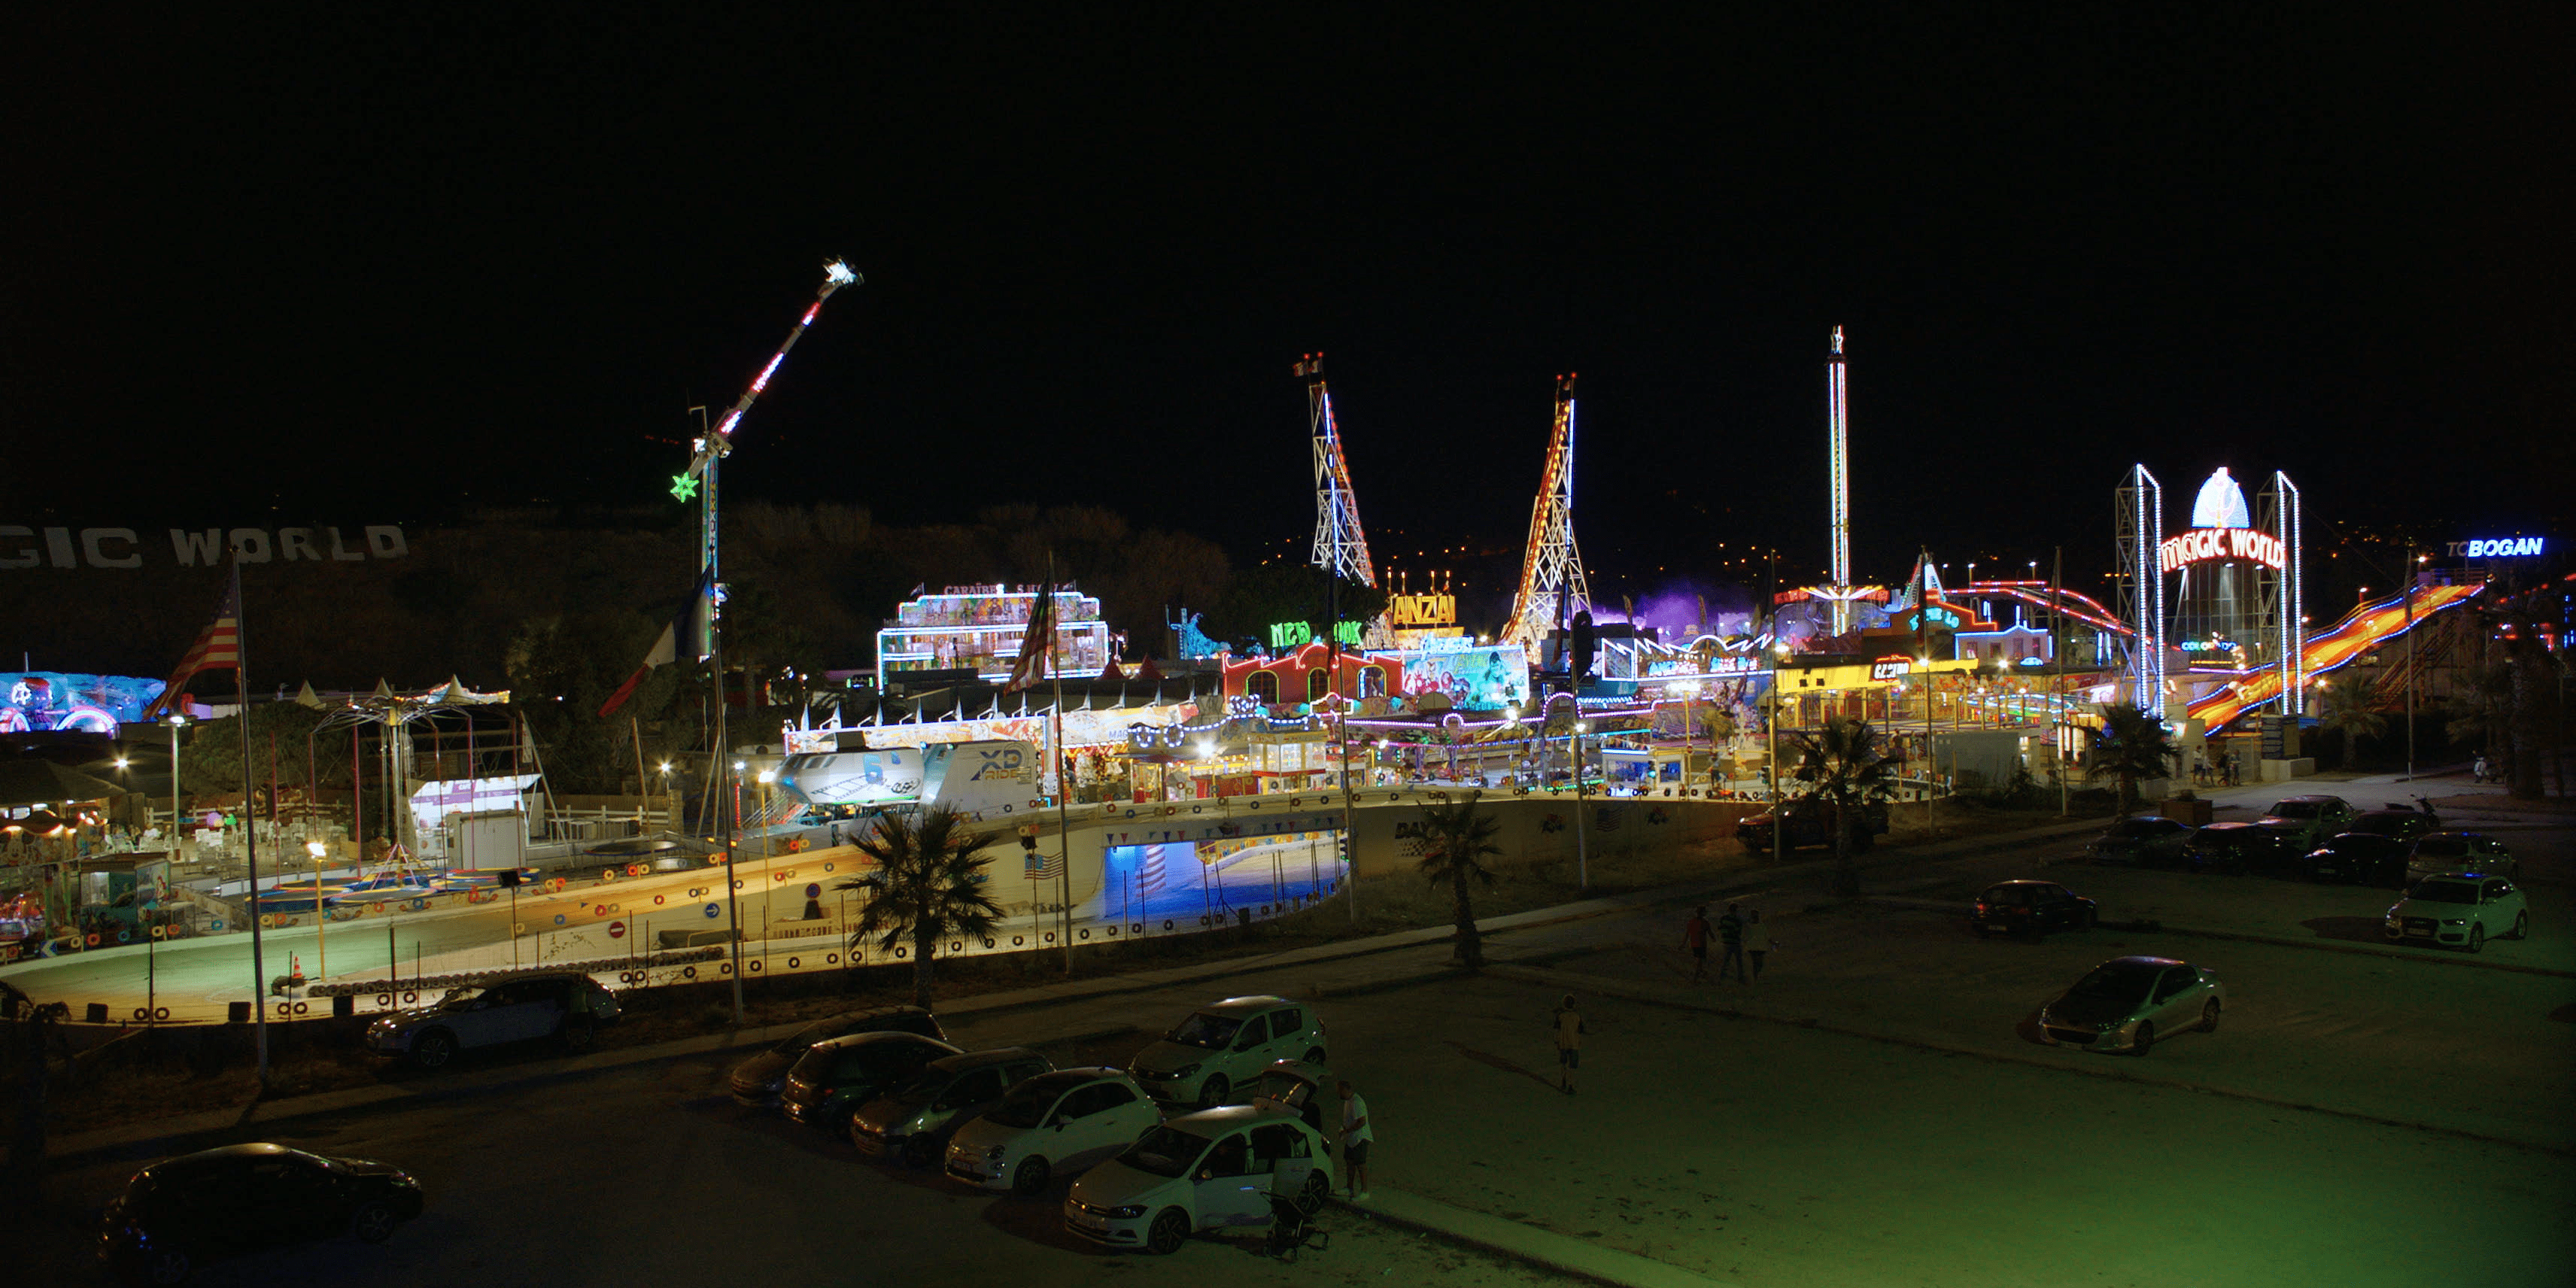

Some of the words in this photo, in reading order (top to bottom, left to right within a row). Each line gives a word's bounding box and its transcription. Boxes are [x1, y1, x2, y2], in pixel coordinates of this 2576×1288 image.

[170, 526, 409, 567] WORLD
[1385, 595, 1456, 624] ANZAI
[1334, 621, 1363, 646] OOK
